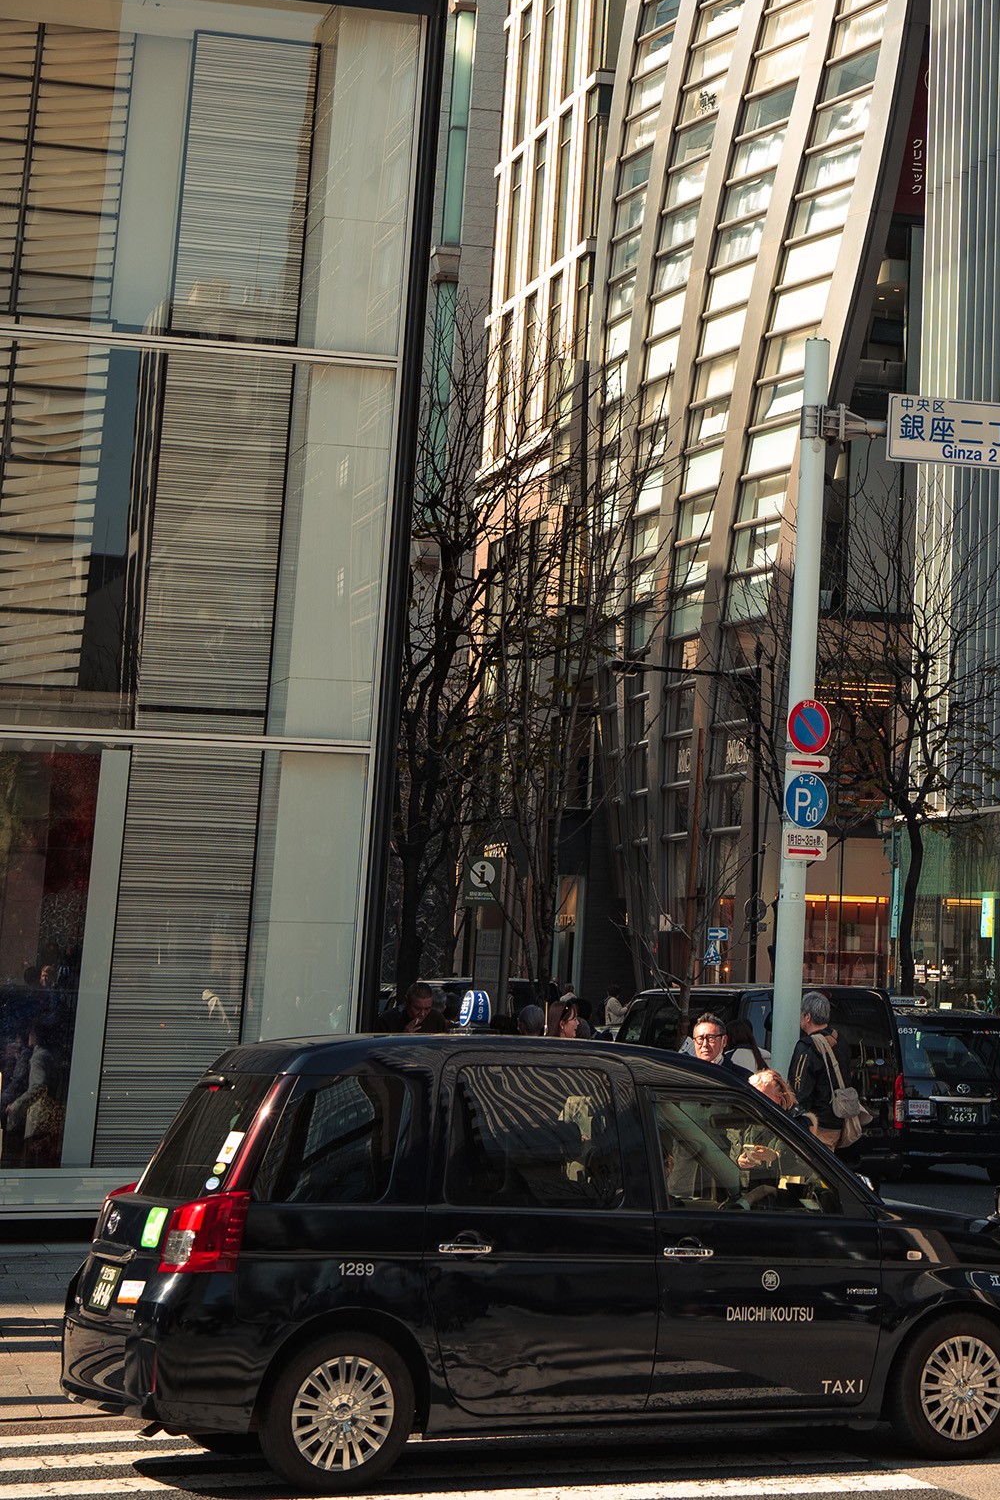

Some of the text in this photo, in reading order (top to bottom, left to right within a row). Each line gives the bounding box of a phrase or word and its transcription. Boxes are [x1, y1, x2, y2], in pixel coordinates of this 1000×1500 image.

[911, 138, 923, 195] クリニック
[901, 397, 945, 414] 中央区
[942, 444, 997, 462] Ginza 2
[799, 776, 817, 786] 9-21
[794, 788, 811, 821] P
[805, 806, 818, 822] 60
[898, 1027, 918, 1035] 6637
[338, 1262, 375, 1276] 1289
[726, 1306, 814, 1322] DAIICHI KOUTSU
[821, 1379, 864, 1394] TAXI
